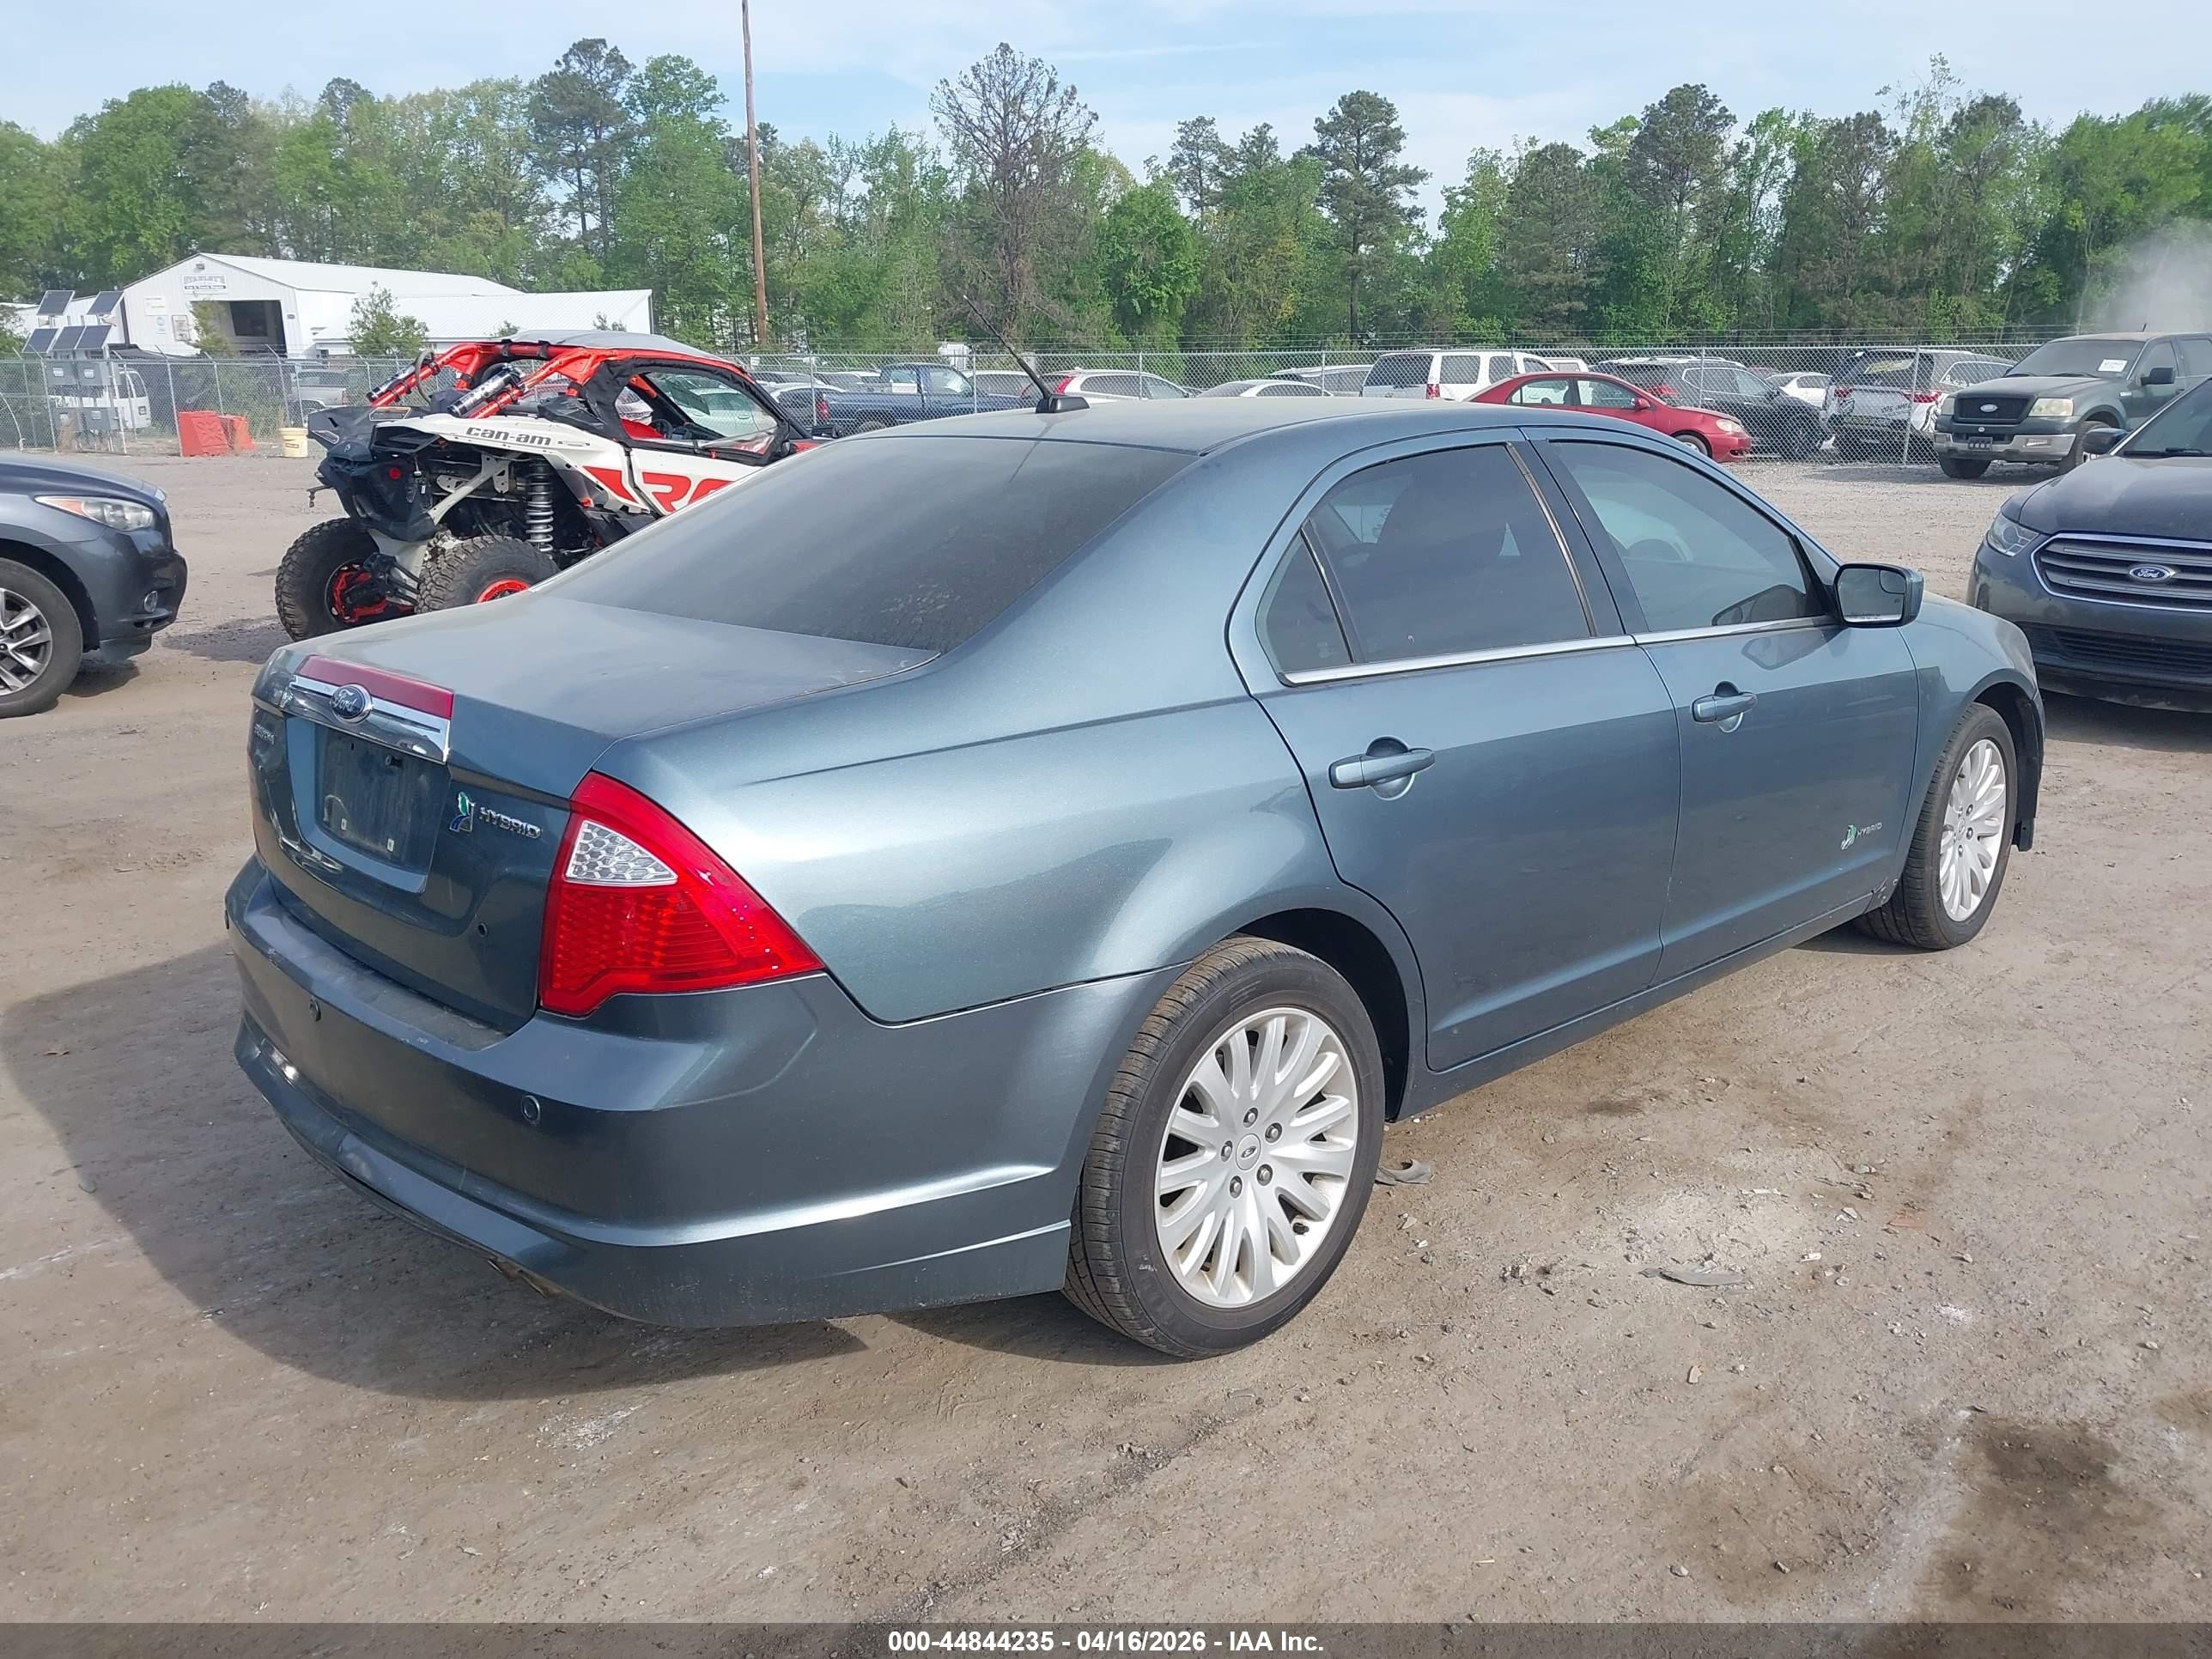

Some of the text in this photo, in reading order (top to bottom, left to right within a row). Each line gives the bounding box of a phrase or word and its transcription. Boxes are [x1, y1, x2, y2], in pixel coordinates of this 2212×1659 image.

[465, 427, 552, 446] can-am
[2137, 568, 2160, 578] Ford
[333, 688, 357, 713] Ford
[479, 806, 542, 839] HYBRID
